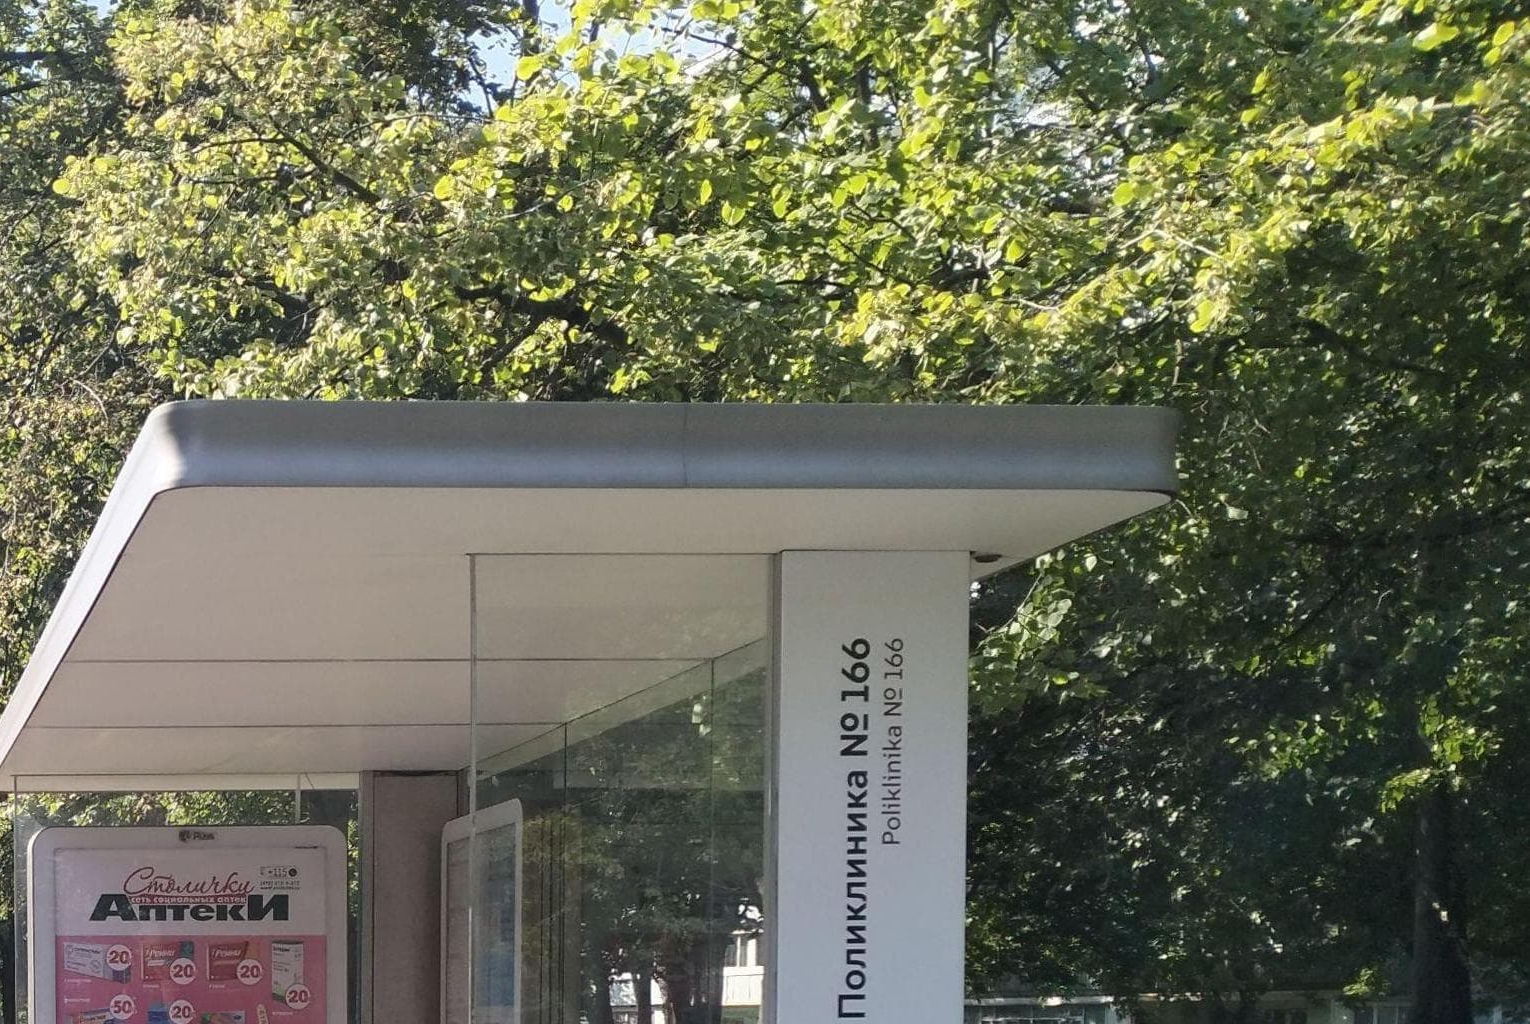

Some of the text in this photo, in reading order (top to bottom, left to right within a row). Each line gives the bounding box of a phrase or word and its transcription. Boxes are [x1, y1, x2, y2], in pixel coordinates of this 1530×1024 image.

[837, 637, 871, 1019] Поликлиника № 166
[881, 637, 904, 846] Poliklinika № 166
[123, 866, 255, 895] Столички
